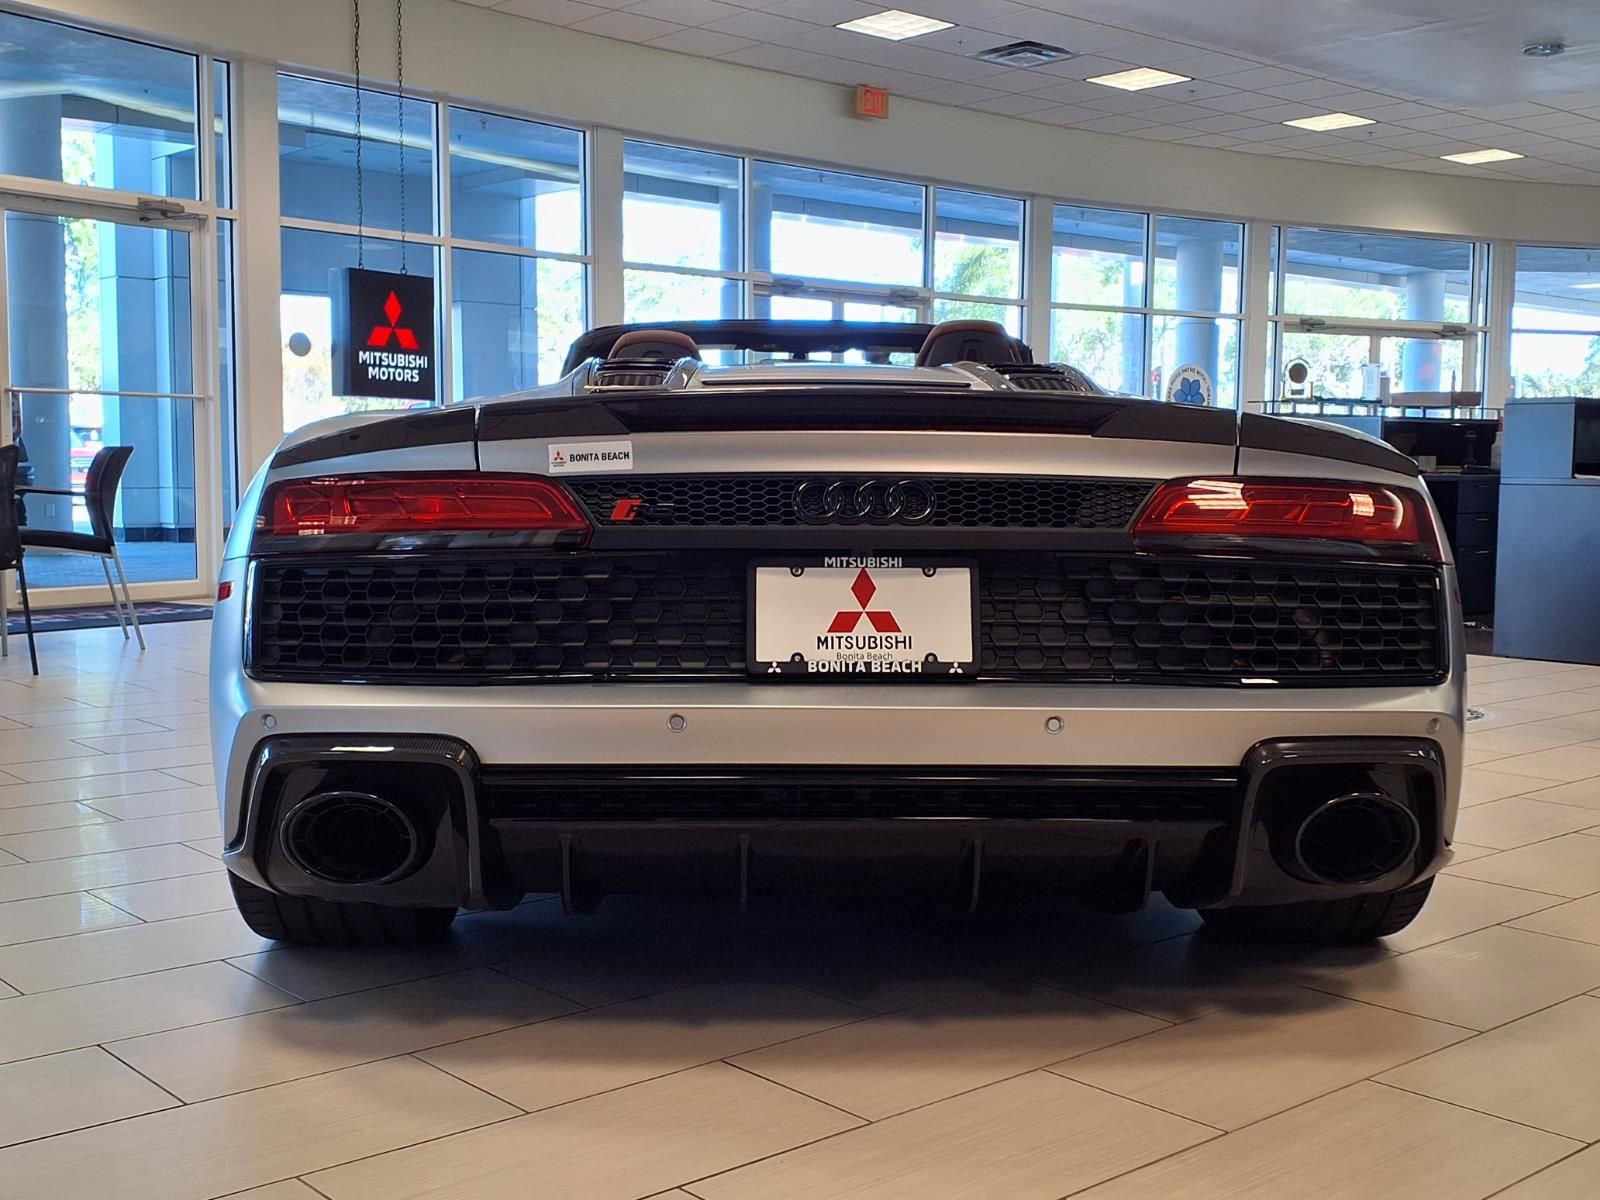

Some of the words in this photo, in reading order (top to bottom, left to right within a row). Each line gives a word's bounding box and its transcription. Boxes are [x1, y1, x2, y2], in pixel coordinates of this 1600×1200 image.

[358, 350, 428, 369] MITSUBISHI
[368, 366, 420, 382] MOTORS
[569, 452, 600, 463] BONITA
[601, 451, 630, 461] BEACH
[824, 557, 903, 568] MITSUBISHI
[816, 635, 912, 650] MITSUBISHI
[836, 652, 865, 661] Bonita
[866, 652, 893, 660] Beach
[807, 660, 866, 673] BONITA
[871, 660, 922, 673] BEACH
